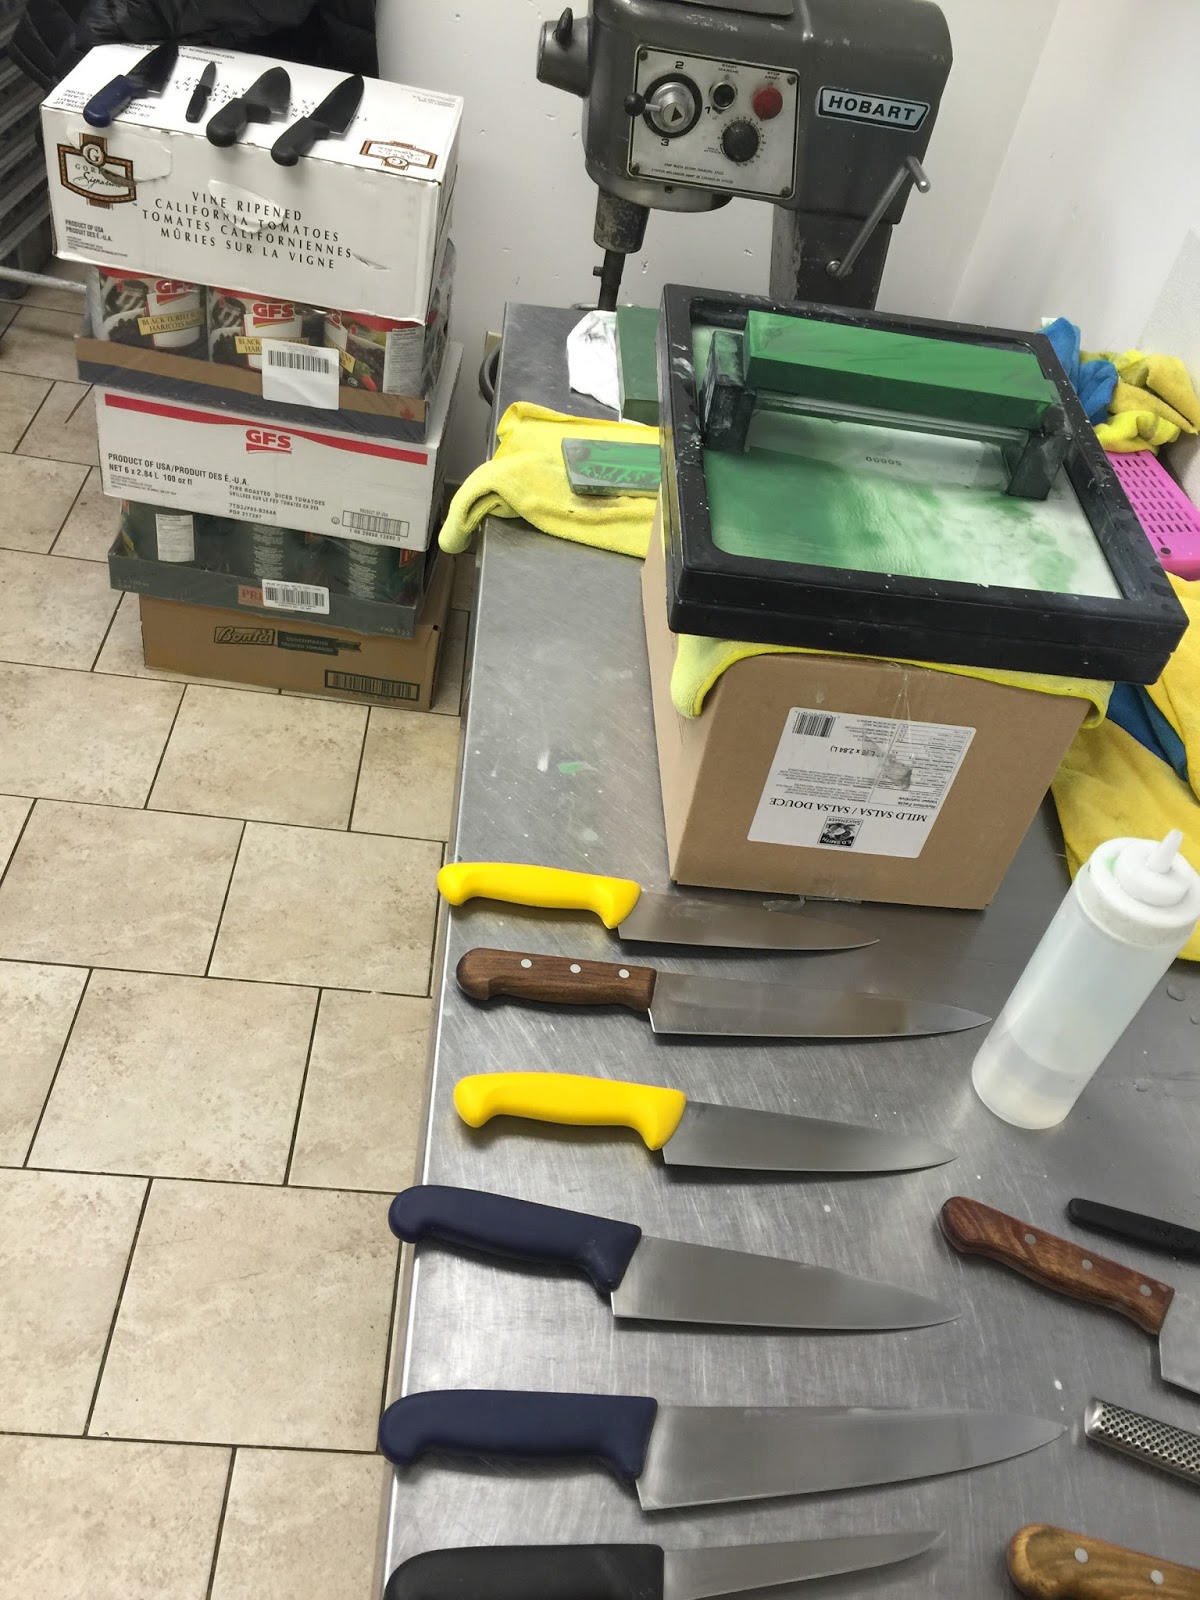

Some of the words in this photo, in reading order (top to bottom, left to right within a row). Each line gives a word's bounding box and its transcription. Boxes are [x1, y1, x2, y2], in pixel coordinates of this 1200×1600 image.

[675, 61, 684, 70] 2
[705, 106, 710, 114] 1
[828, 95, 916, 120] HOBART
[661, 138, 669, 146] 3
[87, 148, 100, 162] G
[192, 191, 226, 208] VINE
[237, 200, 302, 221] RIPENED
[65, 219, 86, 229] PRODUCT
[155, 198, 248, 226] CALIFORNIA
[258, 219, 339, 242] TOMATOES
[66, 226, 86, 236] PRODUIT
[87, 231, 96, 239] DES
[142, 209, 210, 232] TOMATES
[221, 225, 352, 258] CALIFORNIENNES
[160, 226, 216, 246] MÛRIES
[226, 241, 252, 254] SUR
[263, 247, 279, 258] LA
[289, 252, 334, 269] VIGNE
[253, 303, 294, 318] GFS
[238, 338, 262, 346] BLACK
[246, 429, 292, 449] GFS
[108, 453, 142, 467] PRODUCT
[144, 460, 154, 468] OF
[156, 462, 206, 478] USA/PRODUIT
[208, 471, 223, 481] DES
[224, 472, 249, 486] É.-U.A.
[109, 463, 122, 473] NET
[124, 466, 129, 474] 6
[137, 468, 153, 478] 2.84
[163, 474, 176, 482] 100
[245, 488, 270, 496] ROASTED
[295, 496, 325, 506] TOMATOES
[769, 797, 814, 810] DOUCE
[817, 803, 850, 814] SALSA
[860, 808, 894, 819] SALSA
[896, 812, 928, 822] MILD
